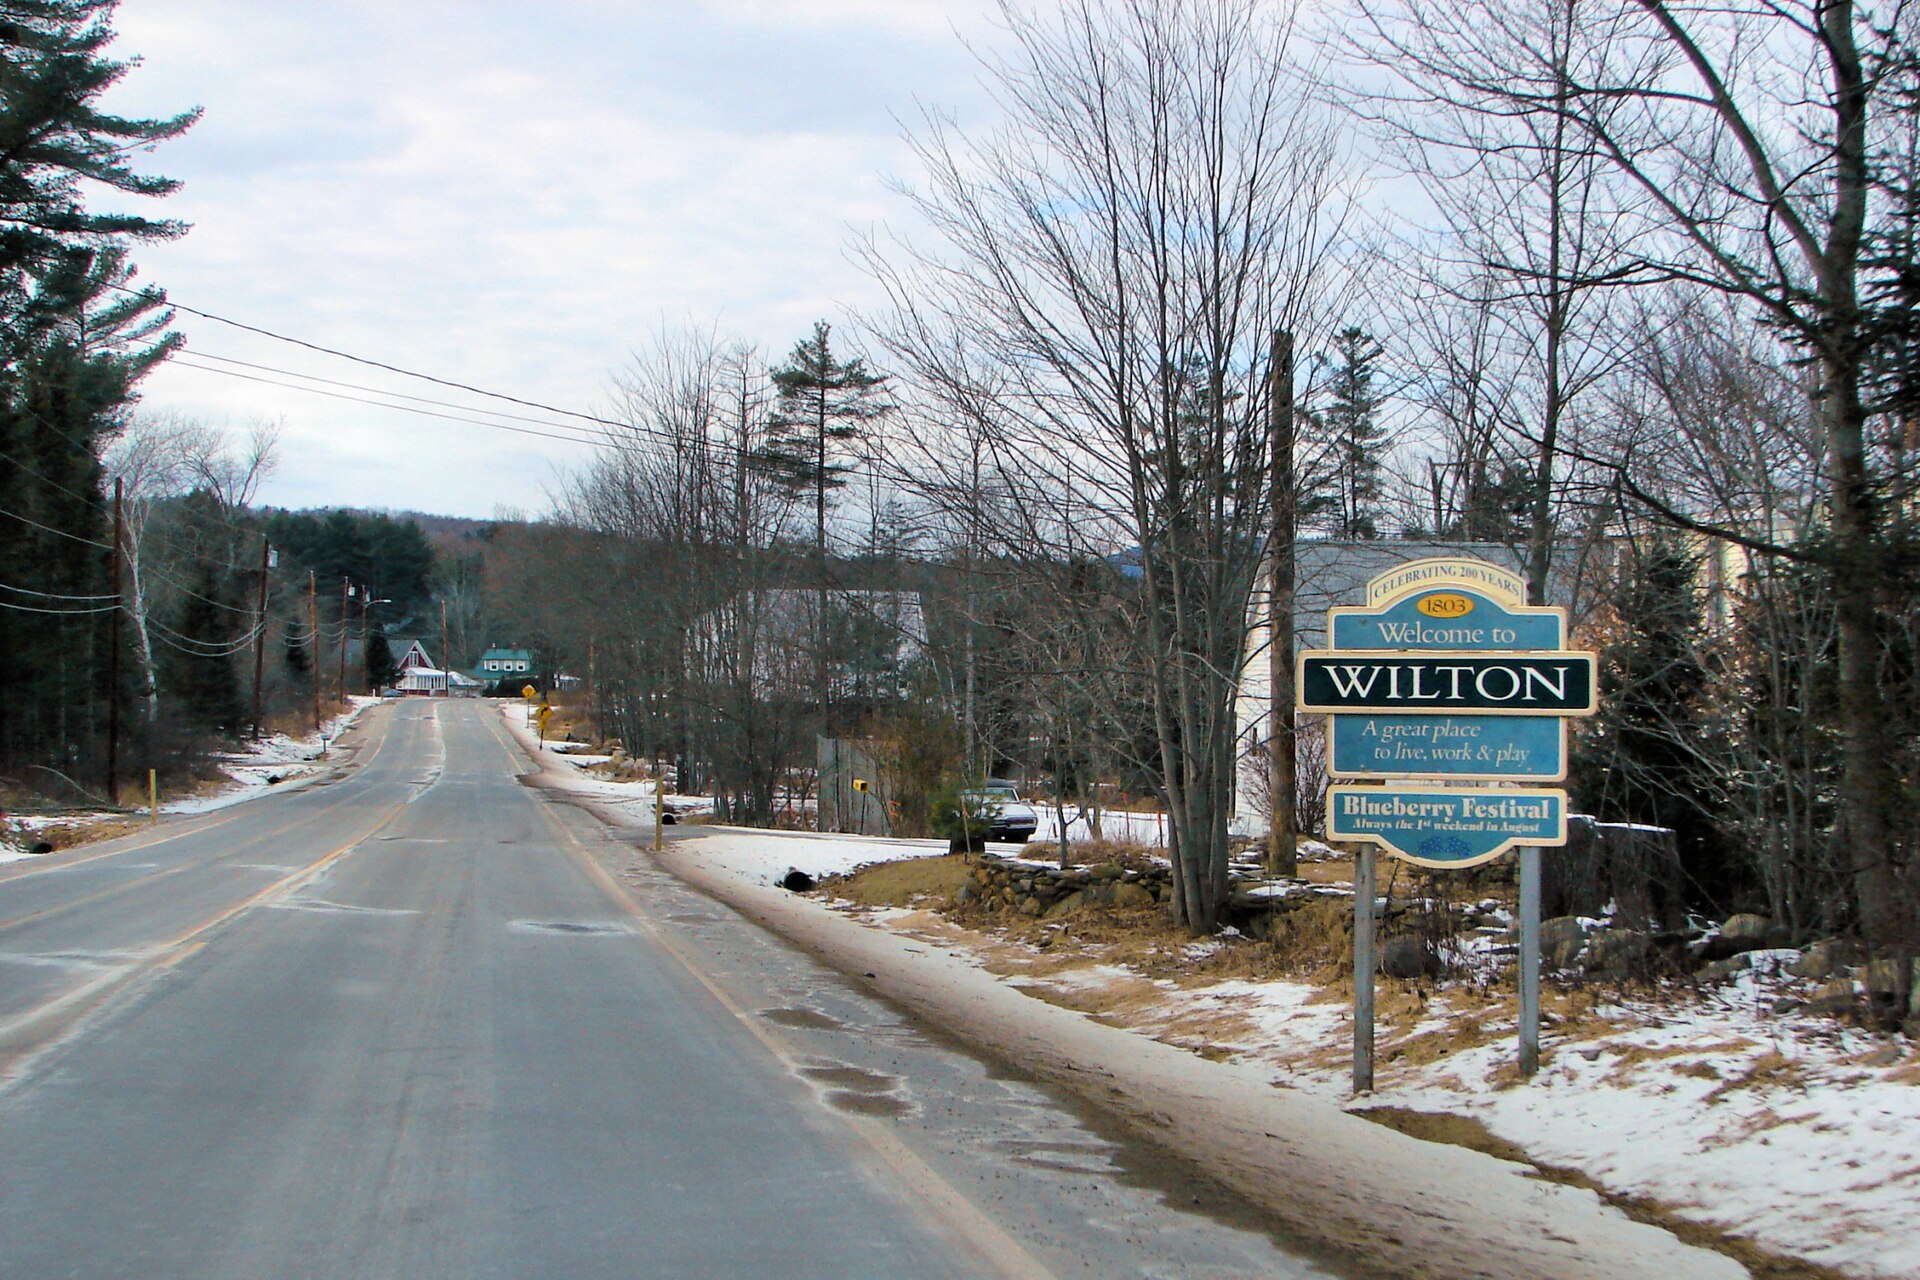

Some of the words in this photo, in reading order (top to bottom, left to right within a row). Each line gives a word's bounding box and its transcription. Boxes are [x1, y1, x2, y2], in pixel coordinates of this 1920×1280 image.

[1374, 565, 1456, 598] CELEBRATING
[1460, 566, 1478, 578] 200
[1480, 570, 1520, 596] YEARS
[1426, 599, 1466, 612] 1803
[1378, 621, 1484, 644] Welcome
[1492, 628, 1516, 644] to
[1321, 665, 1569, 701] WILTON
[1362, 720, 1377, 736] A
[1381, 725, 1429, 744] great
[1432, 719, 1481, 743] place
[1374, 747, 1391, 760] to
[1394, 743, 1427, 761] live,
[1432, 743, 1472, 761] work
[1476, 745, 1492, 761] &
[1496, 743, 1530, 767] play
[1343, 795, 1456, 822] Blueberry
[1462, 798, 1549, 819] Festival
[1353, 818, 1392, 831] Always
[1395, 819, 1415, 830] the
[1417, 819, 1431, 830] 1st
[1434, 820, 1484, 831] weekend
[1486, 821, 1497, 831] in
[1499, 821, 1540, 833] August
